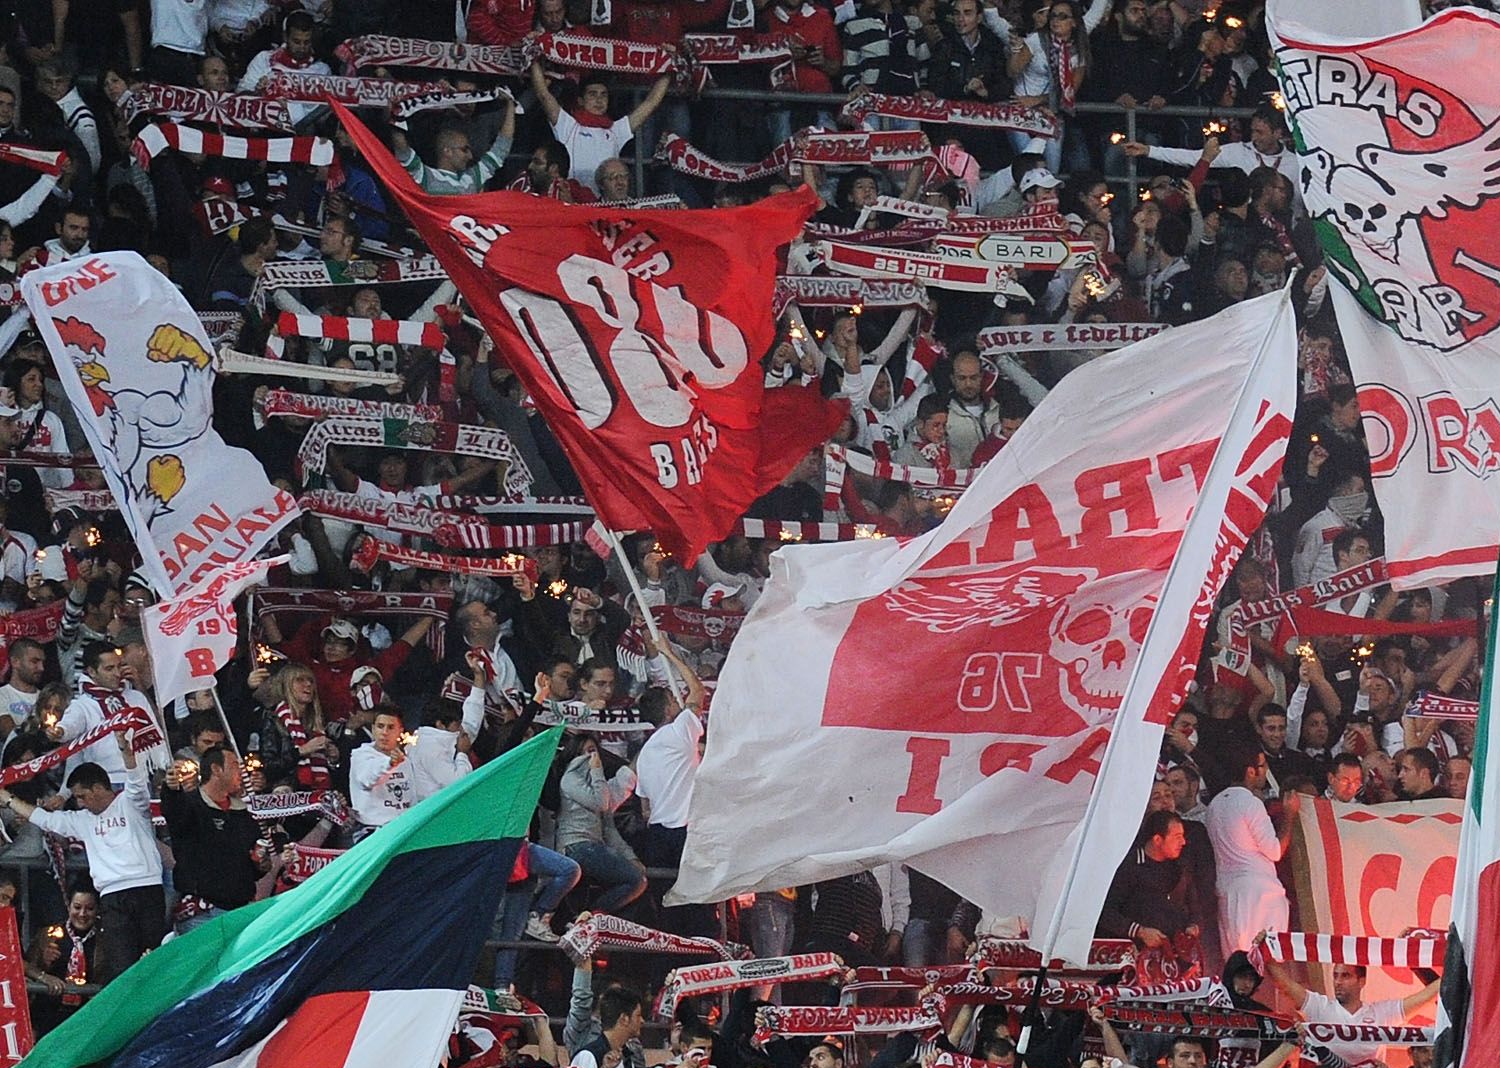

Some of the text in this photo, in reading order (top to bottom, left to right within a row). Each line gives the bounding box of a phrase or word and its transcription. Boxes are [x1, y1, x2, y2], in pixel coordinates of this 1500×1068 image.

[540, 32, 607, 67] Forza
[996, 244, 1052, 259] BARI
[874, 256, 945, 279] as bari
[680, 952, 834, 985] FORZA BARI
[783, 1008, 857, 1028] FORZA
[1308, 1024, 1428, 1042] CURVA
